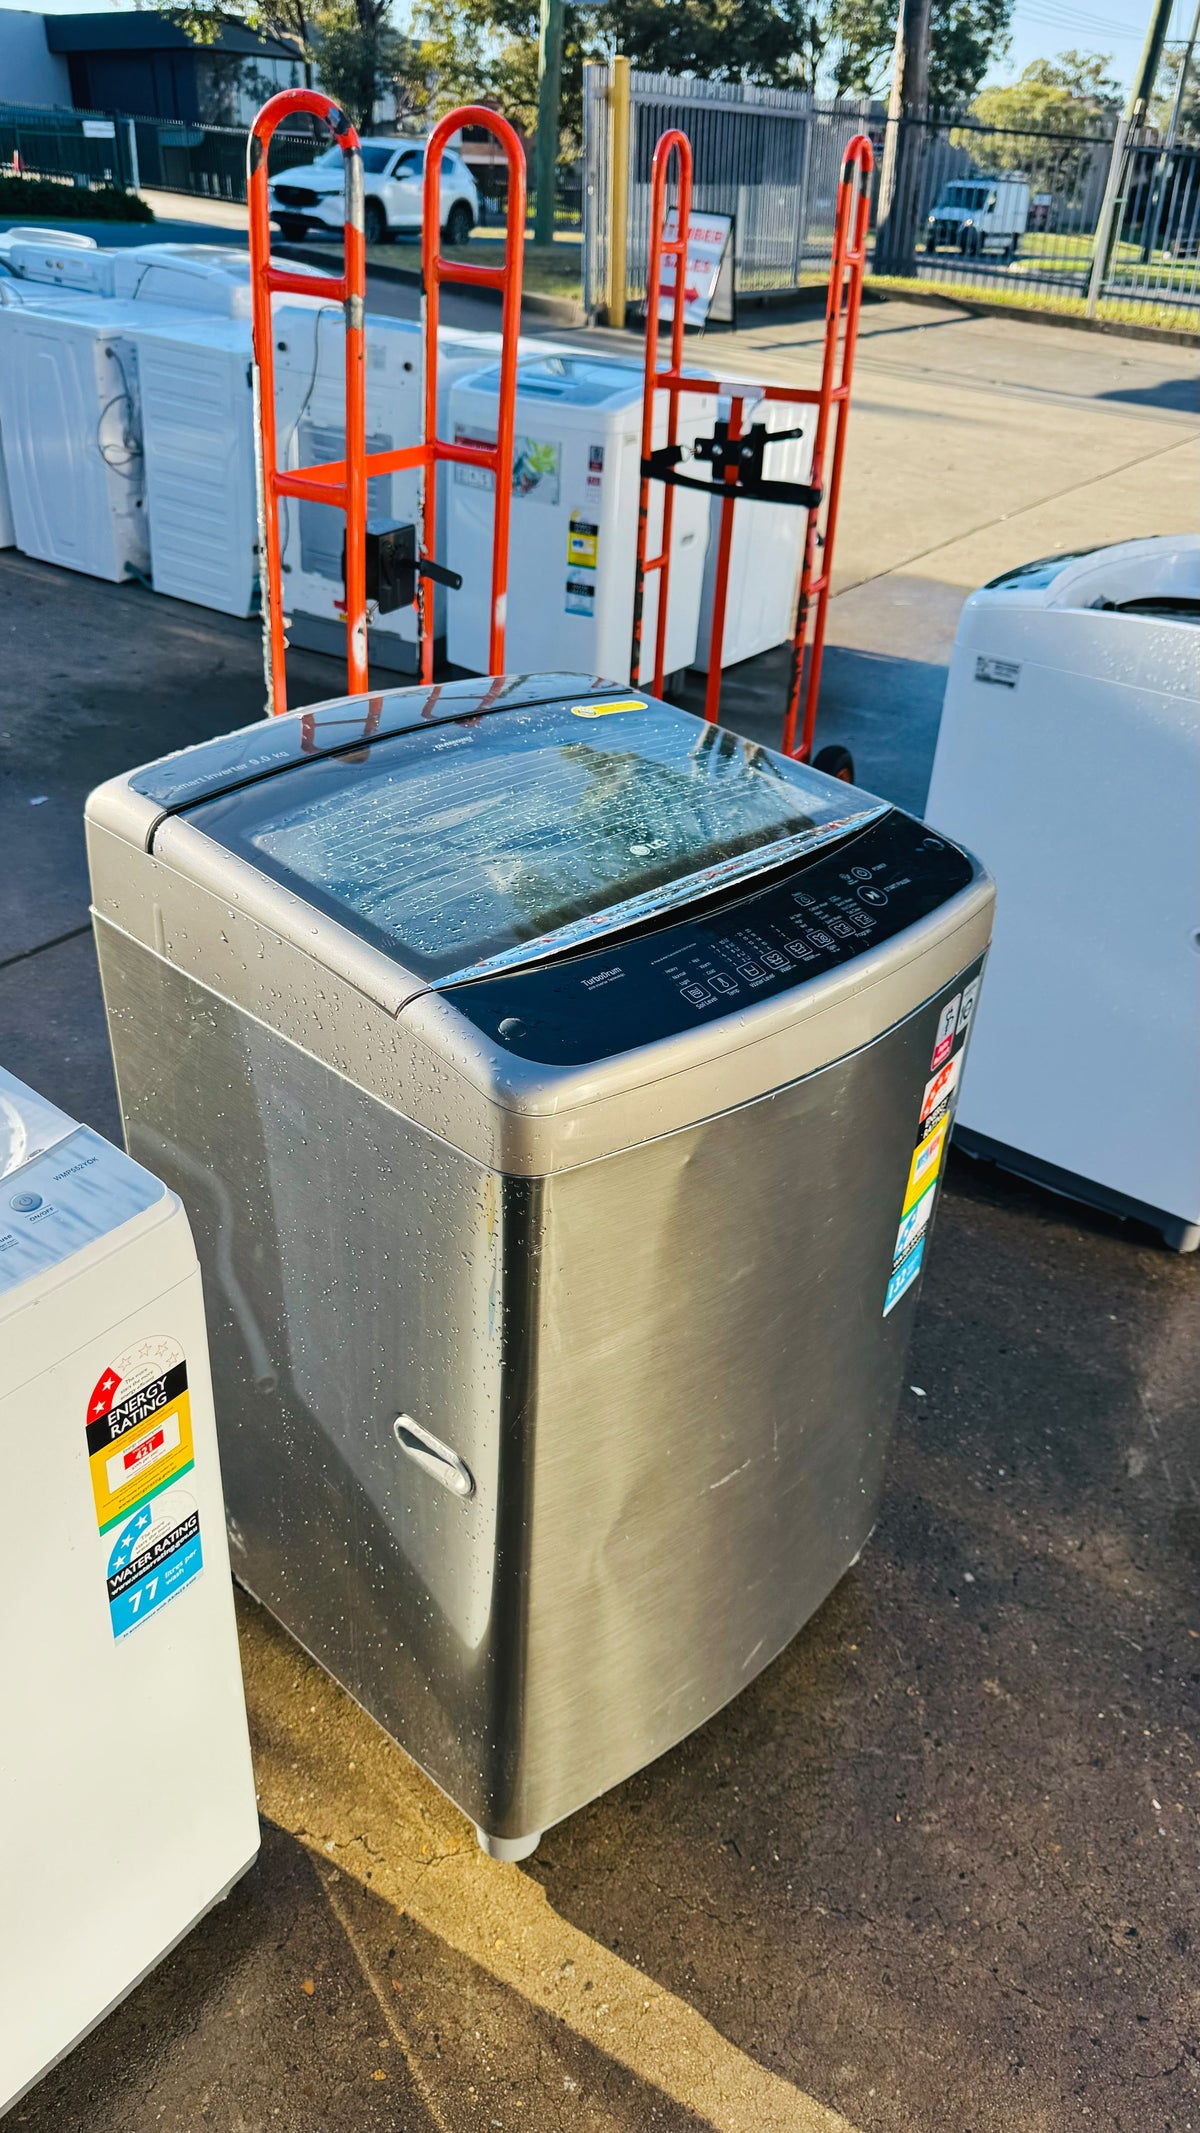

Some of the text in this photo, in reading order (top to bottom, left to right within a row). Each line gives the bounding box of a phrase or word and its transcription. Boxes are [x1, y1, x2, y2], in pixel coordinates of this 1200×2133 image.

[169, 776, 206, 793] Smart
[205, 763, 249, 782] Inverter
[271, 750, 290, 760] kg
[645, 839, 669, 850] LG
[580, 966, 623, 987] TurboDrum
[29, 1206, 55, 1223] ON/OFF
[107, 1376, 168, 1427] ENERGY
[110, 1391, 168, 1440] RATING
[135, 1441, 153, 1460] 421
[109, 1515, 197, 1588] WATER RATING
[164, 1548, 198, 1580] litres per
[165, 1567, 184, 1586] wash
[128, 1576, 159, 1614] 77
